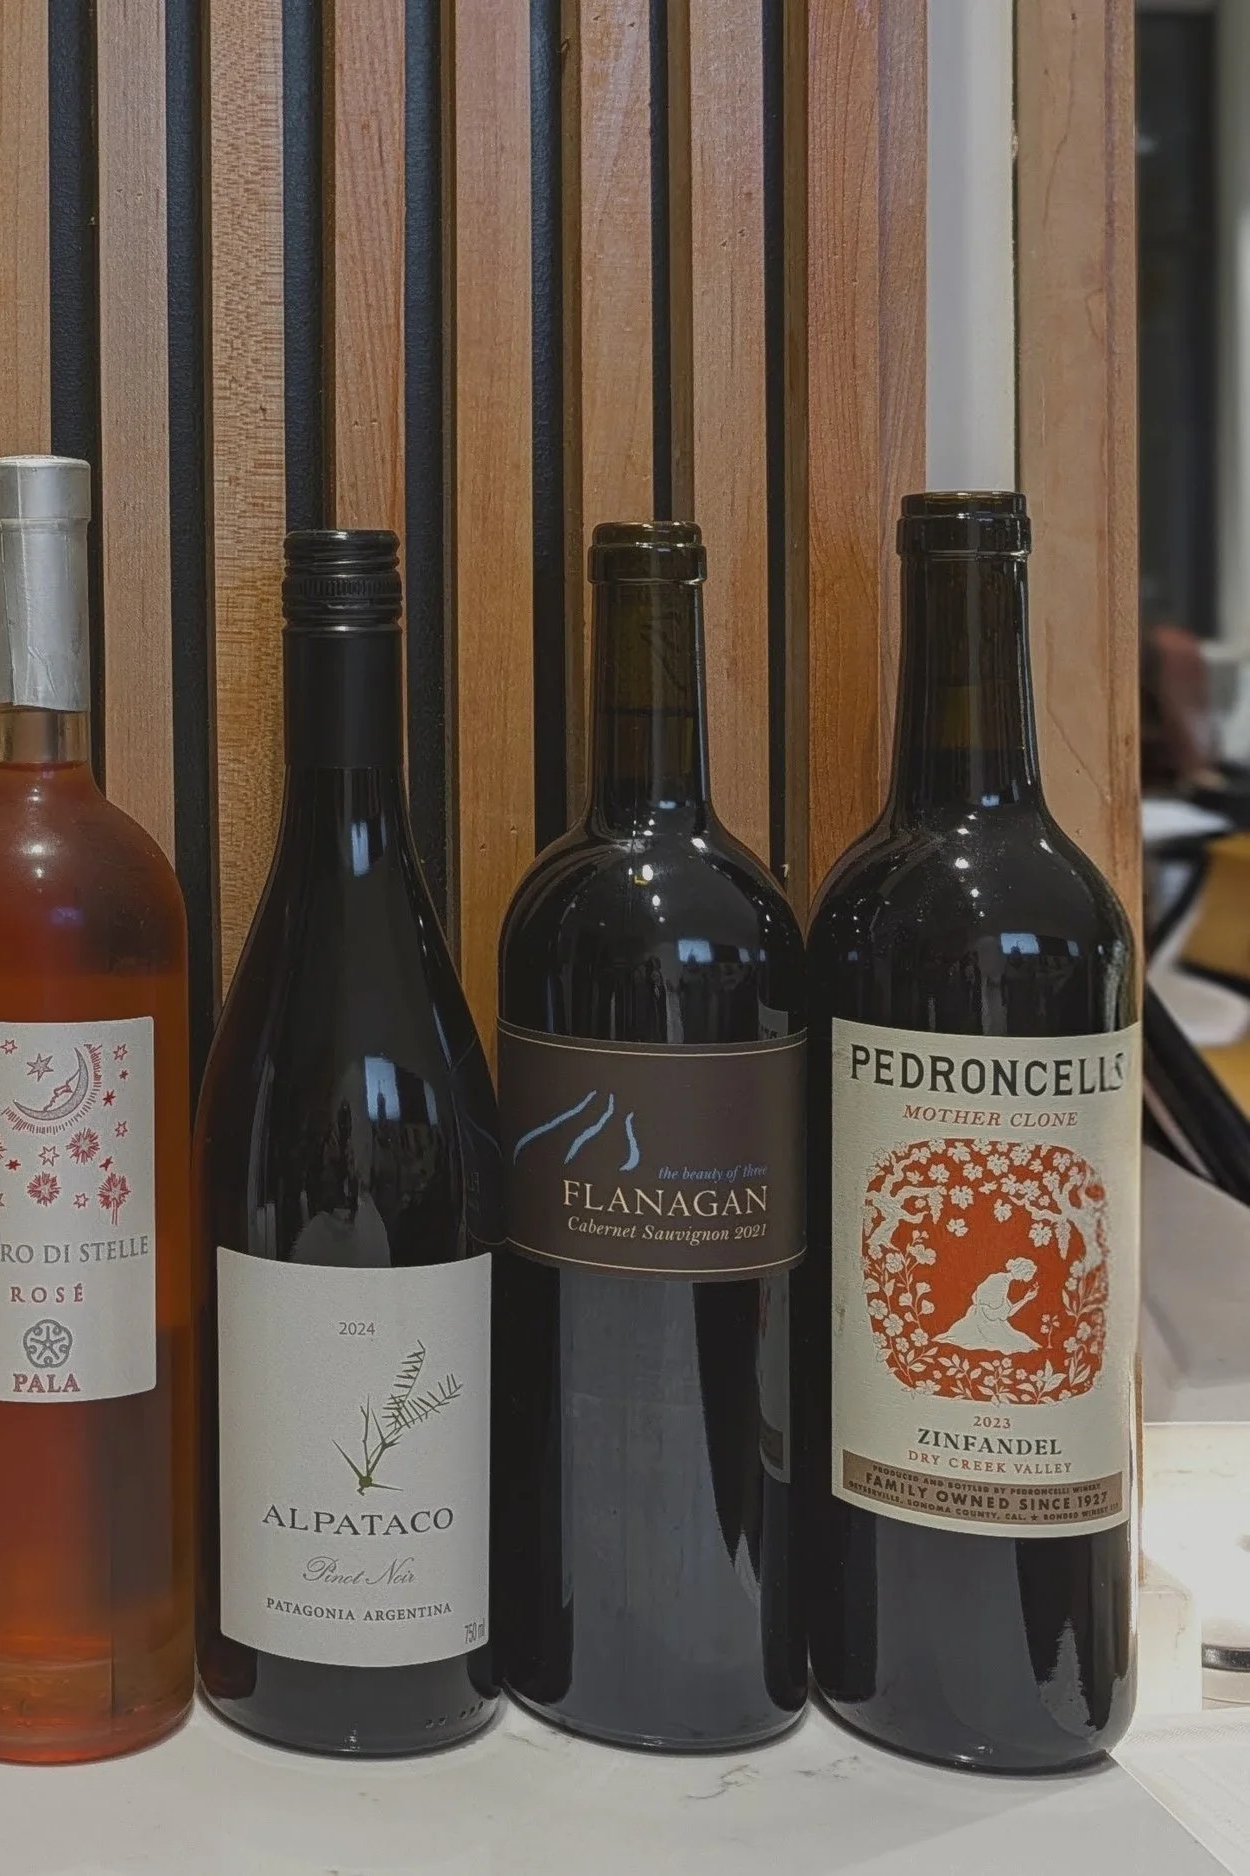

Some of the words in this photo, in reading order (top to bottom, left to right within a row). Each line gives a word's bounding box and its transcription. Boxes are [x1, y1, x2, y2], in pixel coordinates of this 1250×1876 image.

[902, 1105, 1002, 1127] MOTHER
[1009, 1111, 1080, 1128] CLONE
[658, 1166, 679, 1180] the
[682, 1165, 722, 1184] beauty
[726, 1164, 742, 1184] of
[563, 1179, 768, 1217] FLANAGAN
[568, 1215, 637, 1239] Cabernet
[641, 1224, 730, 1247] Sauvignon
[734, 1223, 767, 1240] 2021
[43, 1244, 71, 1264] DI
[79, 1235, 150, 1262] STELLE
[10, 1282, 84, 1303] ROSÉ
[338, 1321, 376, 1336] 2024
[12, 1373, 81, 1393] PALA
[972, 1415, 1012, 1430] 2023
[917, 1428, 1063, 1456] ZINFANDEL
[908, 1449, 940, 1466] DRY
[948, 1457, 1007, 1474] CREEK
[1014, 1462, 1072, 1475] VALLEY
[865, 1472, 928, 1499] FAMILY
[935, 1489, 1010, 1511] OWNED
[1019, 1497, 1071, 1511] SINCE
[1077, 1491, 1109, 1509] 1927
[873, 1464, 919, 1482] PRODUCED
[923, 1477, 944, 1488] AND
[947, 1481, 990, 1493] BOTTLED
[993, 1486, 1007, 1495] BY
[1010, 1486, 1071, 1497] PEDRONCELLI
[261, 1504, 455, 1536] ALPATACO
[907, 1498, 952, 1514] SONOMA
[1004, 1512, 1028, 1521] CAL.
[303, 1556, 366, 1585] Pinot
[365, 1556, 416, 1586] Noir
[266, 1597, 355, 1621] PATAGONIA
[363, 1602, 453, 1621] ARGENTINA
[464, 1621, 477, 1645] 750
